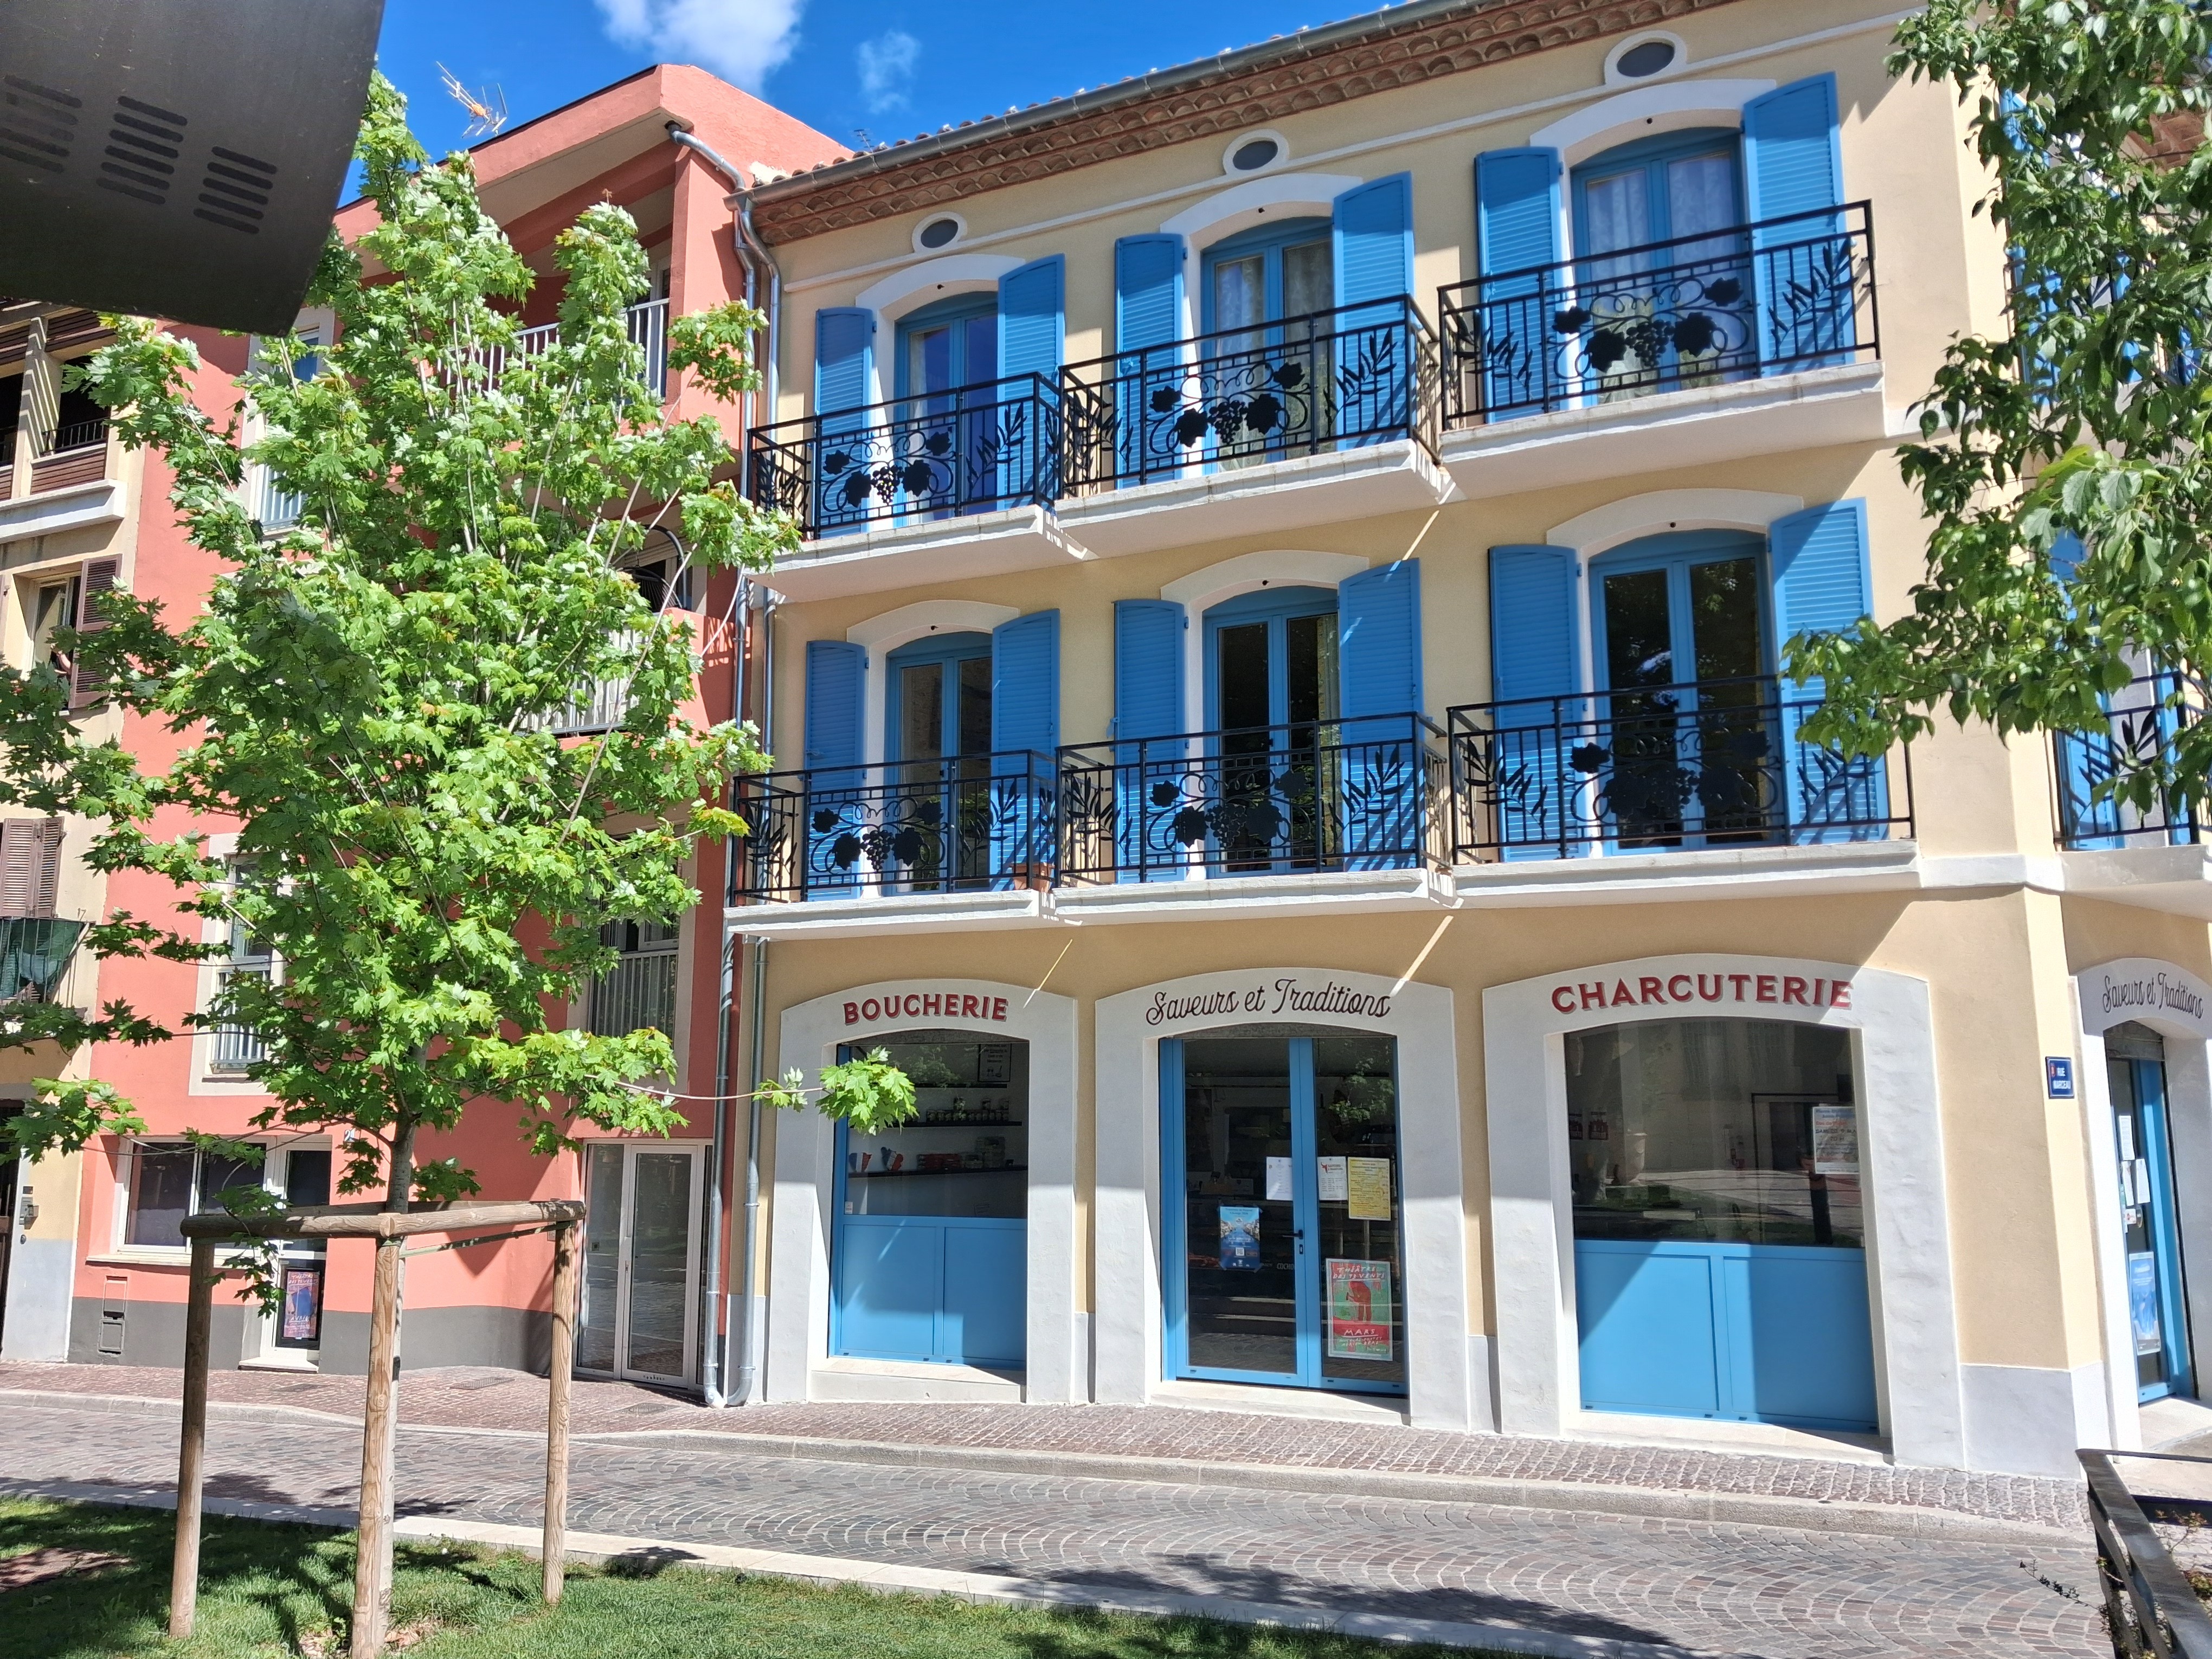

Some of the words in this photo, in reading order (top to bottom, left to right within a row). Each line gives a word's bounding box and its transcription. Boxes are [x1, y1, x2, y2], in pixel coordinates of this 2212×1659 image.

[843, 993, 1009, 1026] BOUCHERIE
[1146, 992, 1240, 1025] Saveurs
[1245, 985, 1265, 1012] et
[1272, 979, 1391, 1018] Traditions
[1551, 974, 1854, 1014] CHARCUTERIE
[2102, 975, 2145, 1013] Saveurs
[2147, 977, 2156, 1005] et
[2158, 972, 2204, 1019] Traditions
[2053, 1080, 2071, 1089] MARCEAU
[2057, 1067, 2066, 1076] RUE
